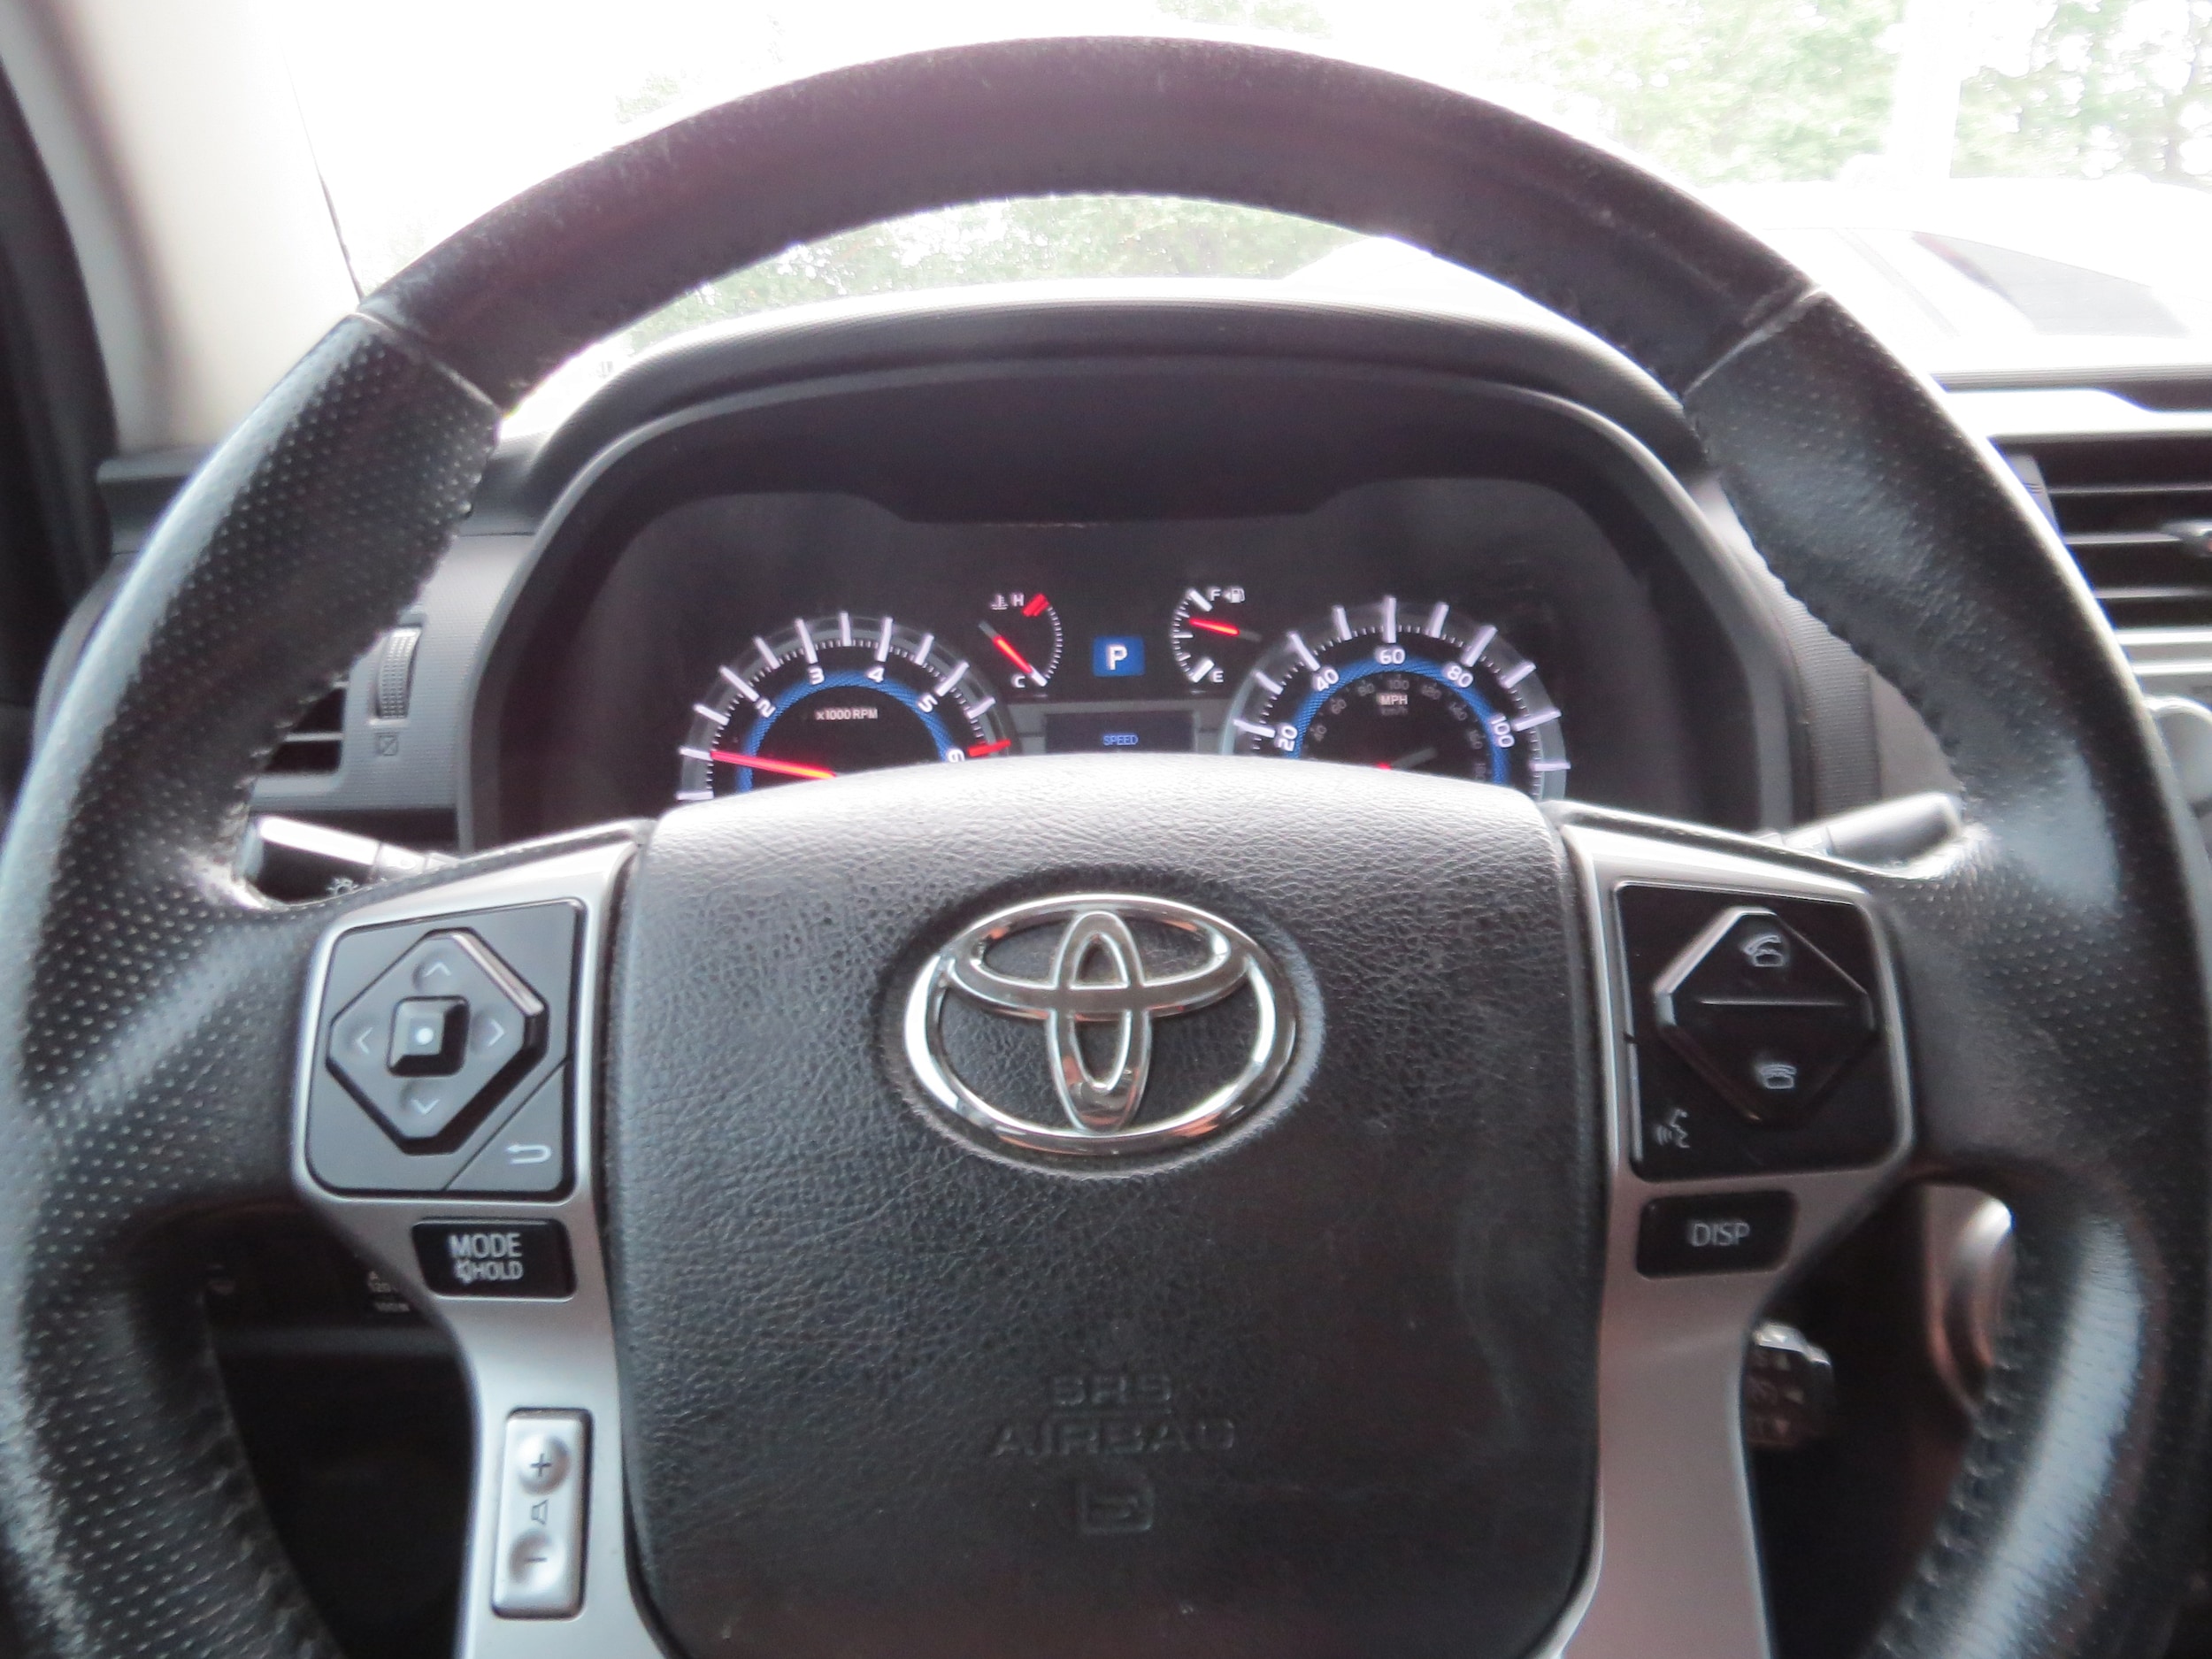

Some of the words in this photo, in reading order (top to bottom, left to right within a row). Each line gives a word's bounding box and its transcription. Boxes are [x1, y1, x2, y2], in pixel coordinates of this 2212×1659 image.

[1011, 593, 1025, 606] H
[1209, 588, 1221, 601] F
[1107, 645, 1128, 670] P
[1378, 648, 1406, 665] 60
[809, 667, 825, 685] 3
[867, 666, 885, 684] 4
[1012, 675, 1025, 688] C
[1210, 670, 1224, 683] E
[1314, 668, 1340, 691] 40
[1445, 664, 1474, 688] 80
[756, 697, 776, 718] 2
[918, 695, 938, 713] 5
[1379, 694, 1409, 706] MPH
[852, 708, 879, 719] RPM
[1102, 733, 1139, 746] SPEED
[1277, 725, 1299, 752] 20
[1490, 715, 1515, 748] 100
[1691, 1221, 1751, 1247] DISP
[448, 1233, 524, 1258] MODE
[472, 1260, 524, 1281] HOLD
